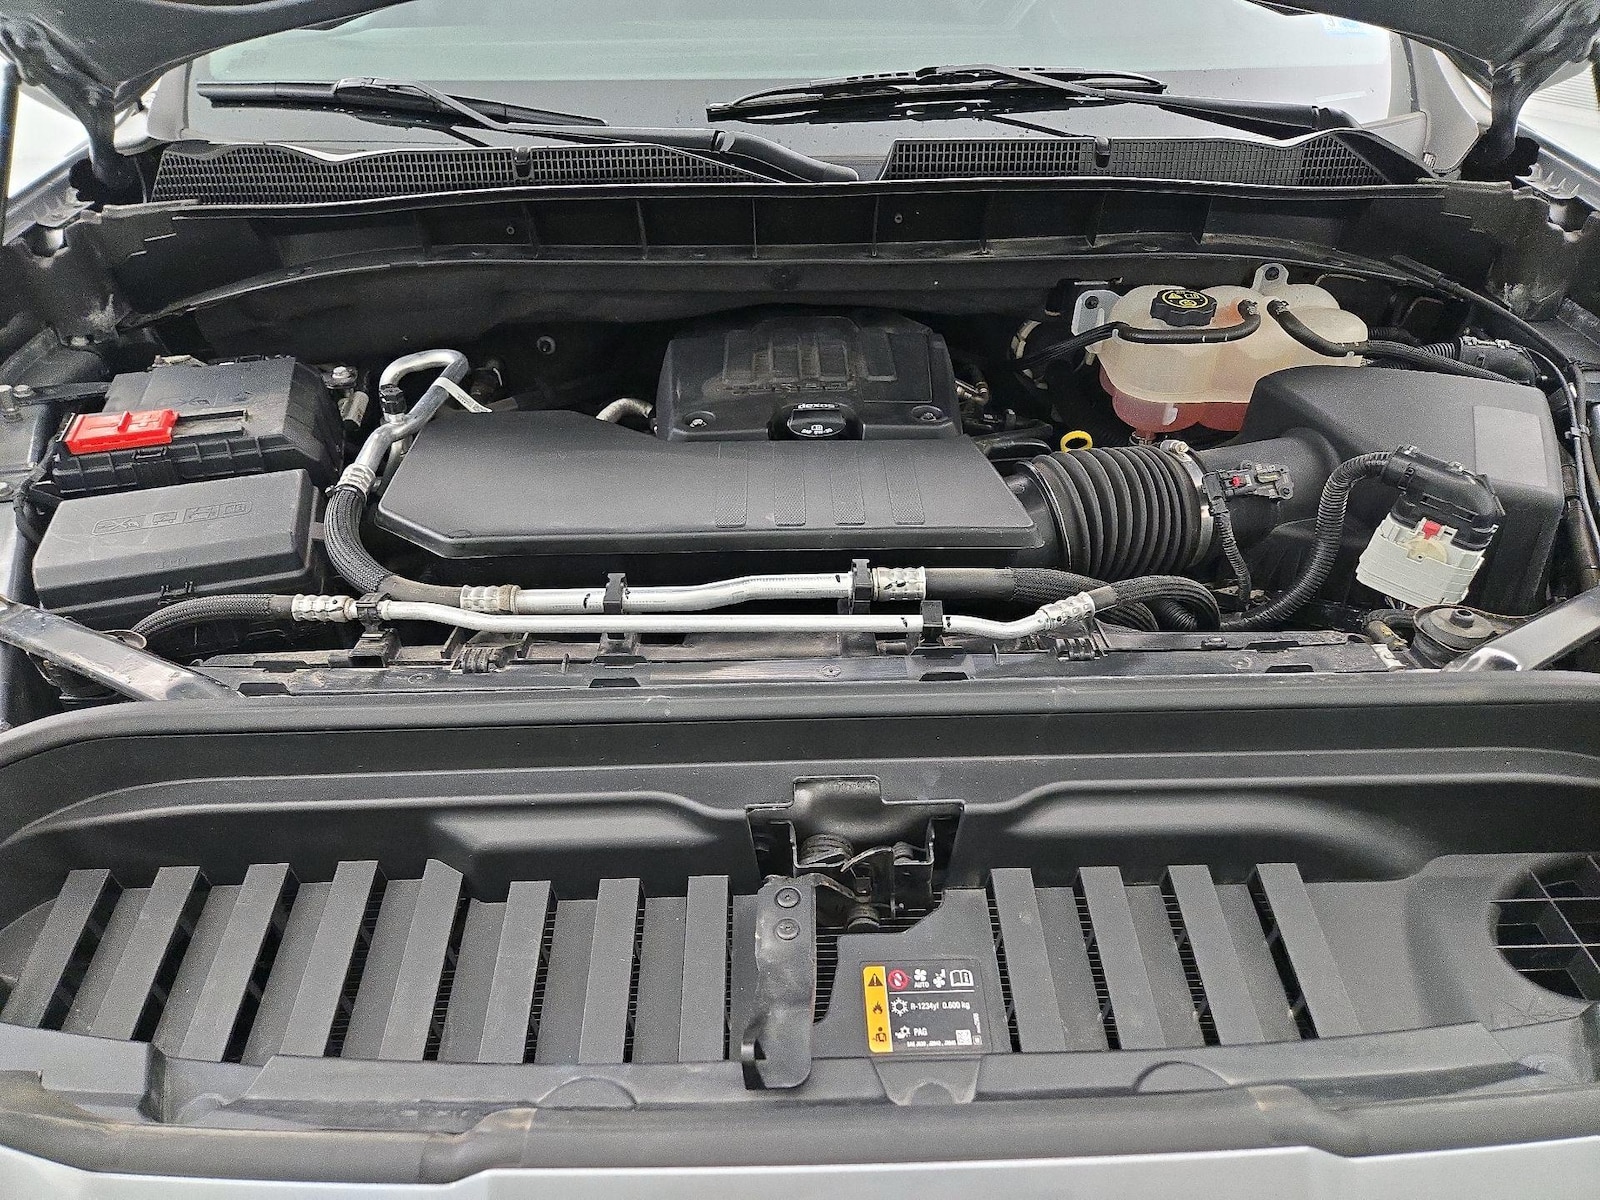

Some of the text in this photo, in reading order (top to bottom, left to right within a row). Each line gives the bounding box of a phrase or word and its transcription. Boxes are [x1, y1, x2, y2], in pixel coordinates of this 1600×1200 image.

[914, 981, 930, 989] AUTO
[961, 1001, 971, 1010] kg
[913, 1027, 928, 1036] PAG
